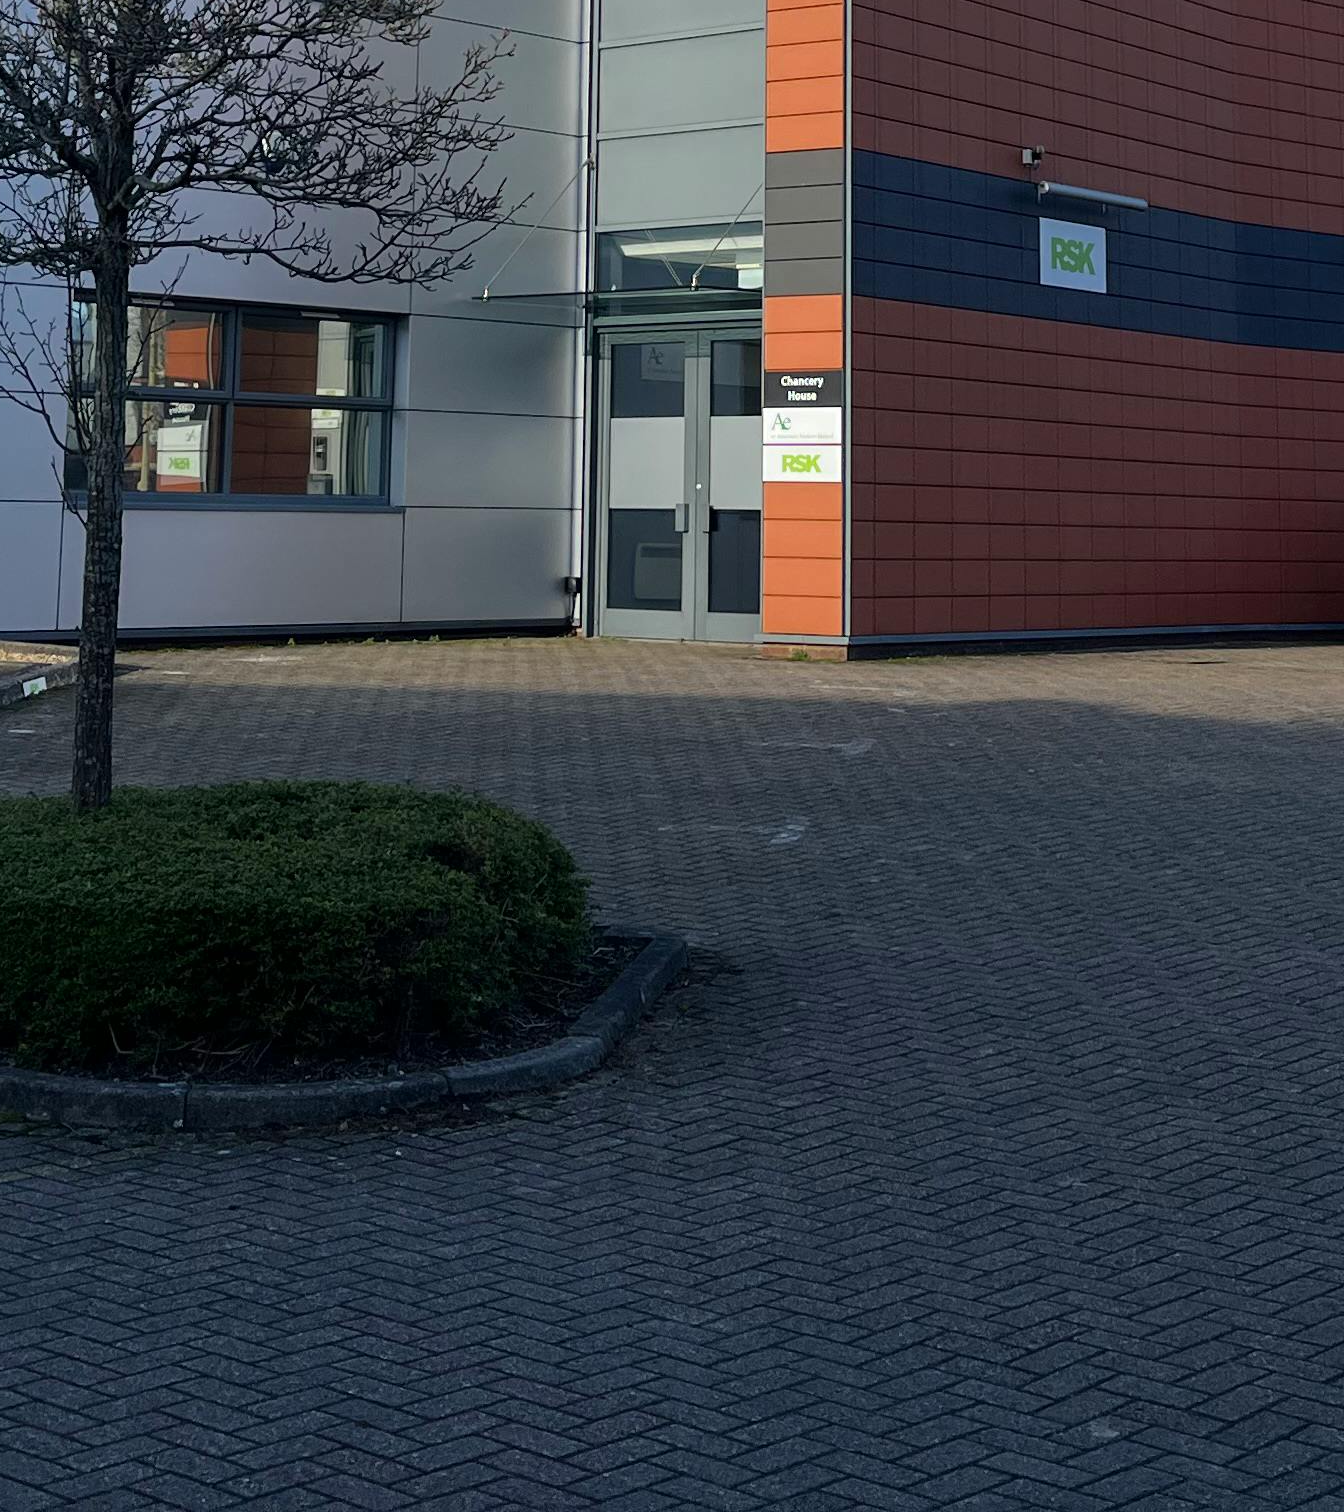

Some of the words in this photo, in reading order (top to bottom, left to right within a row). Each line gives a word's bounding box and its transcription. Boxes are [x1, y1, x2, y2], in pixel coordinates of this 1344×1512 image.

[1050, 236, 1096, 275] RSK
[780, 375, 824, 388] Chancery
[787, 390, 817, 401] House
[782, 454, 822, 473] RSK
